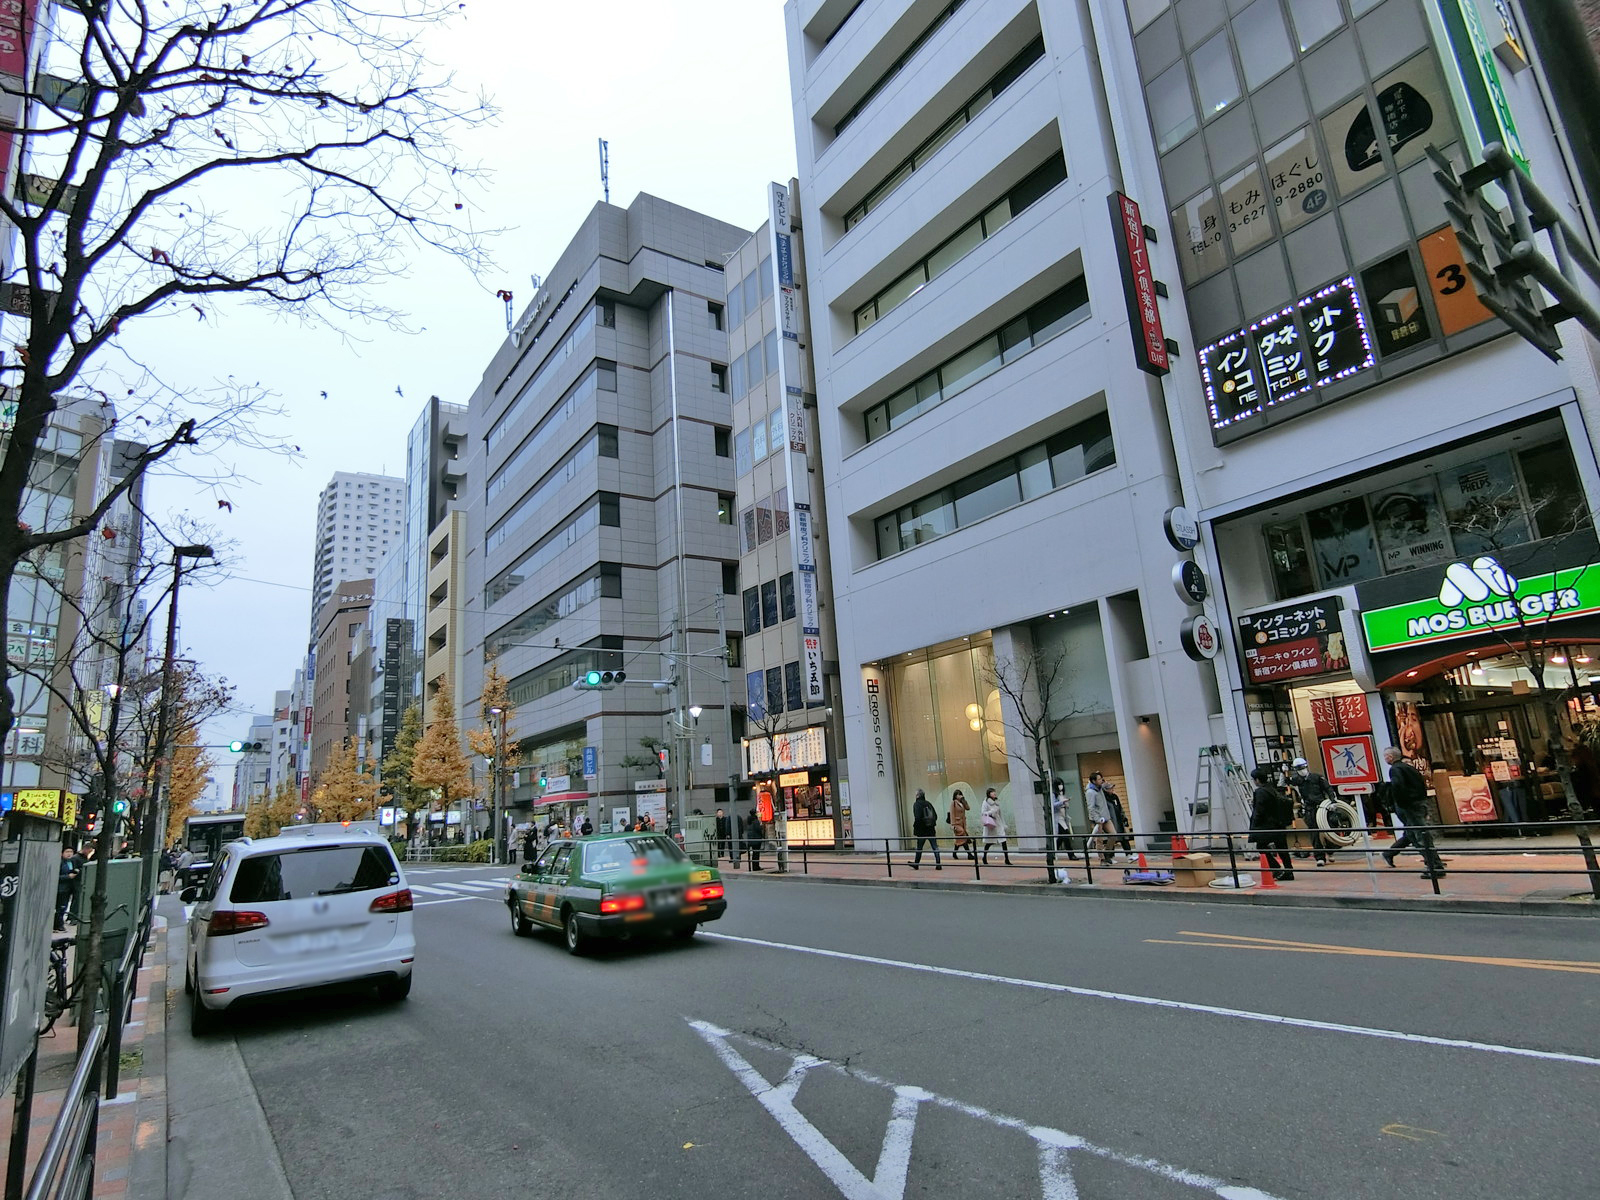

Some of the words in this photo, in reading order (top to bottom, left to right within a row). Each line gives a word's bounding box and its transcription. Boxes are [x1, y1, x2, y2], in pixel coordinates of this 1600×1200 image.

[1124, 200, 1156, 324] 新宿ワイン倶楽部
[793, 442, 803, 450] 5F
[1460, 478, 1492, 494] PHELPS
[1409, 540, 1444, 557] WINNING
[1253, 606, 1325, 630] インターネット
[1408, 609, 1467, 637] MOS
[1467, 588, 1581, 626] BURGER
[808, 651, 820, 696] いち五郎
[1254, 658, 1318, 677] 新宿ワイン倶楽部
[1337, 698, 1349, 733] ラクレット
[1345, 696, 1356, 719] グリル
[1353, 696, 1364, 718] ワイン
[870, 694, 880, 733] CROSS
[875, 737, 885, 778] OFFICE
